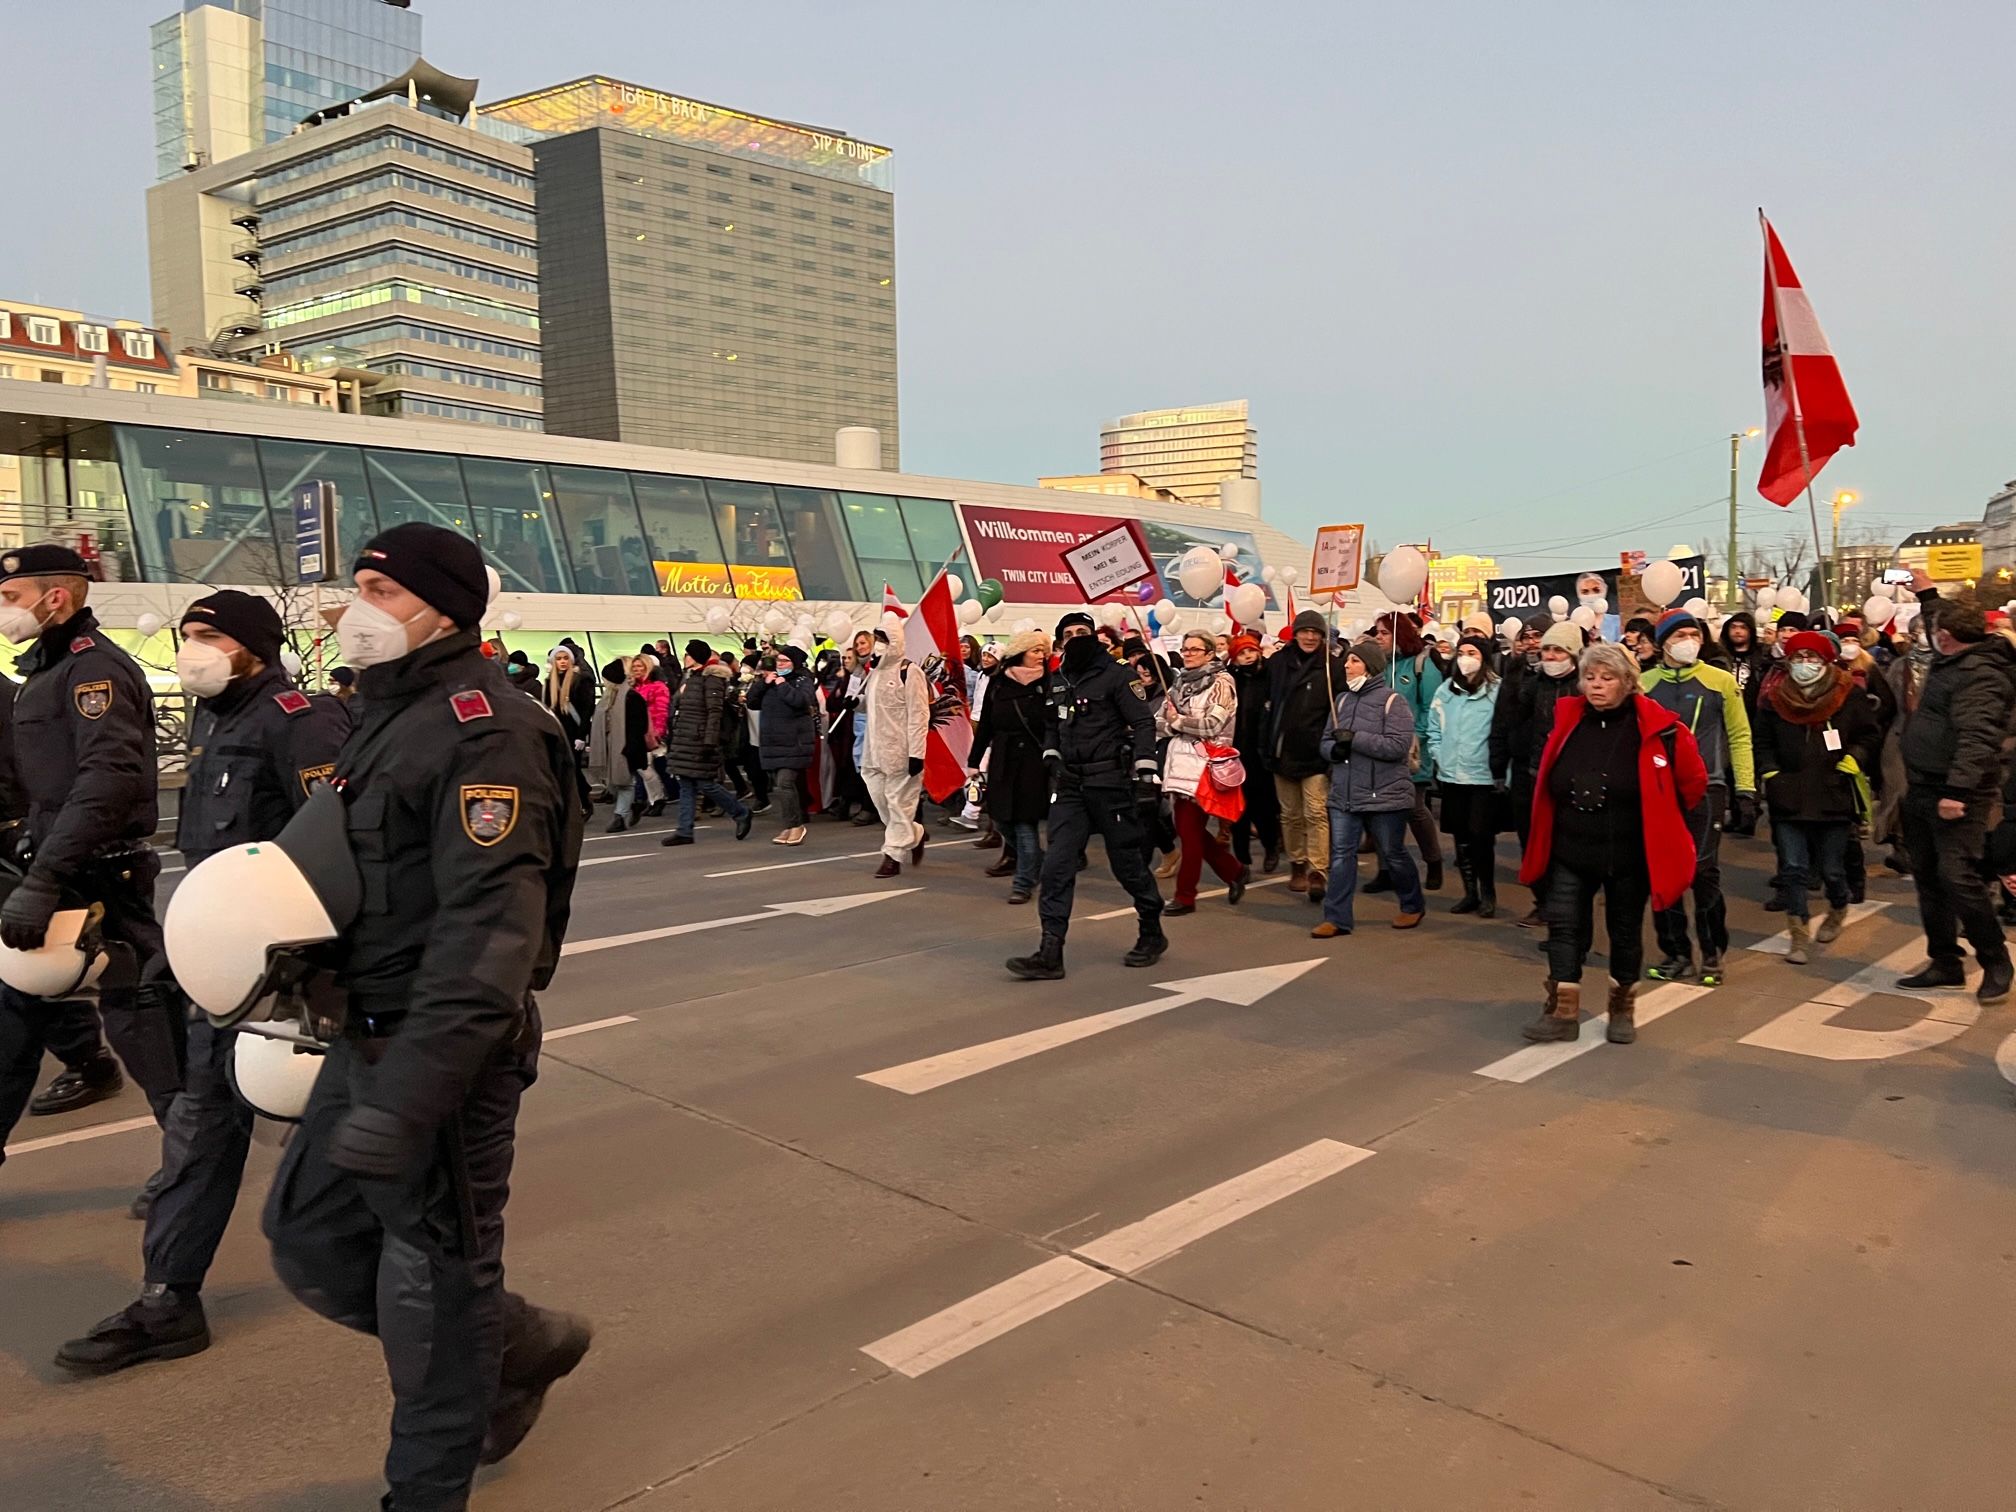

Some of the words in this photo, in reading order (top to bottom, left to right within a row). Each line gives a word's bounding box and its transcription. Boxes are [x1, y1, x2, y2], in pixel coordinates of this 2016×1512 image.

[671, 97, 707, 122] BACK
[974, 519, 1075, 544] Willkommen
[1081, 548, 1101, 562] MEIN
[661, 565, 720, 594] Motto
[1002, 568, 1026, 583] TWIN
[1027, 570, 1048, 584] CITY
[1493, 584, 1540, 609] 2020
